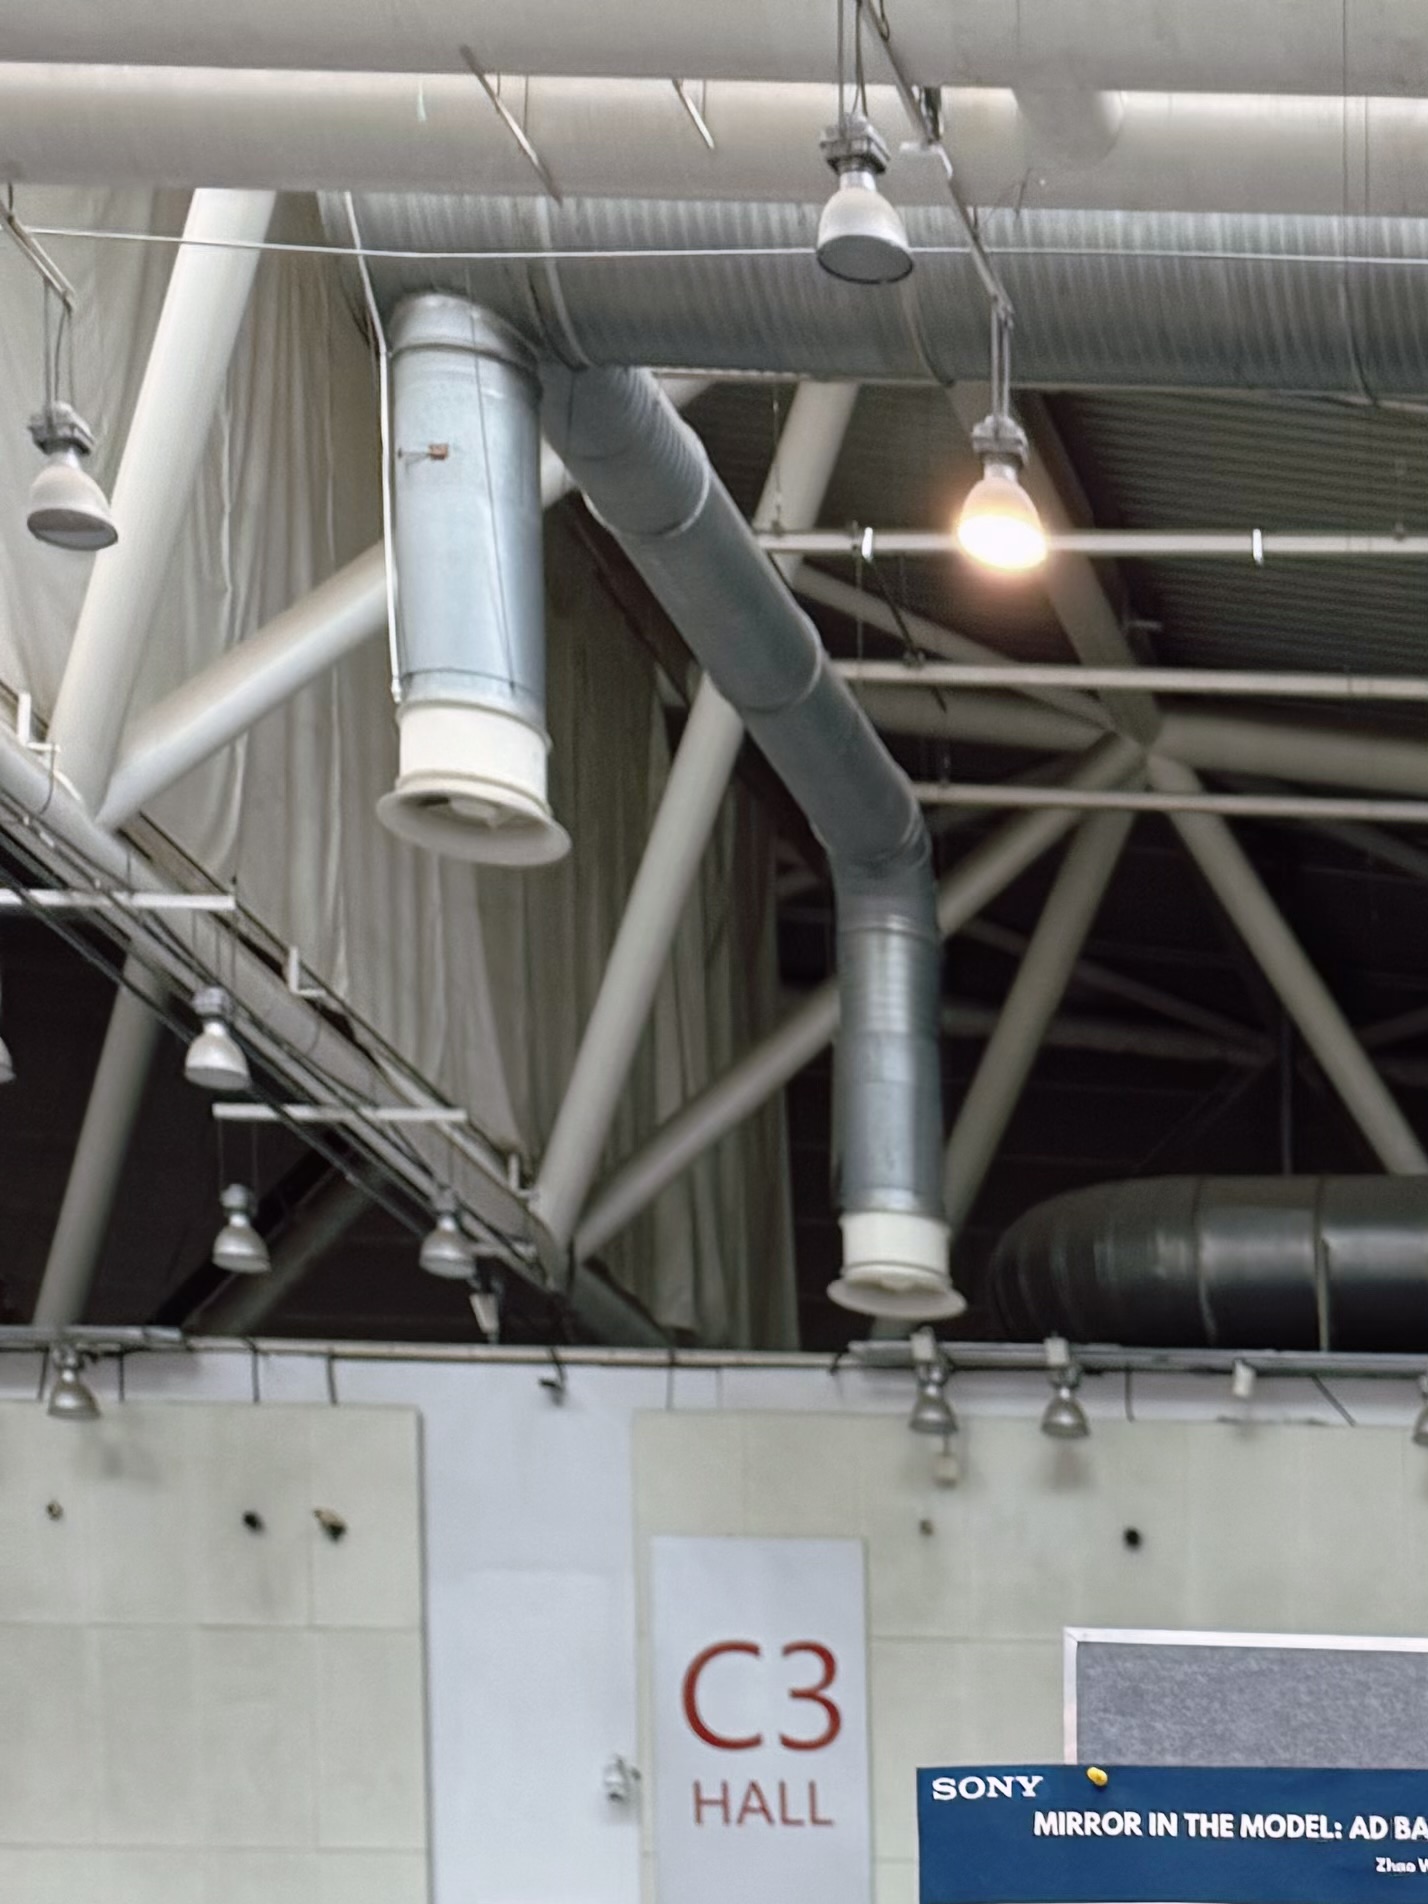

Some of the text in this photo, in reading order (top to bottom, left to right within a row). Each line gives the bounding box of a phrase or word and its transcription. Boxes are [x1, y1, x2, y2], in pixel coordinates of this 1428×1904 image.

[682, 1640, 844, 1752] C3
[693, 1781, 836, 1828] HALL
[931, 1775, 1044, 1801] SONY
[1033, 1810, 1143, 1836] MIRROR
[1148, 1811, 1178, 1837] IN
[1182, 1812, 1234, 1838] THE
[1239, 1813, 1342, 1839] MODEL:
[1348, 1814, 1388, 1840] AD
